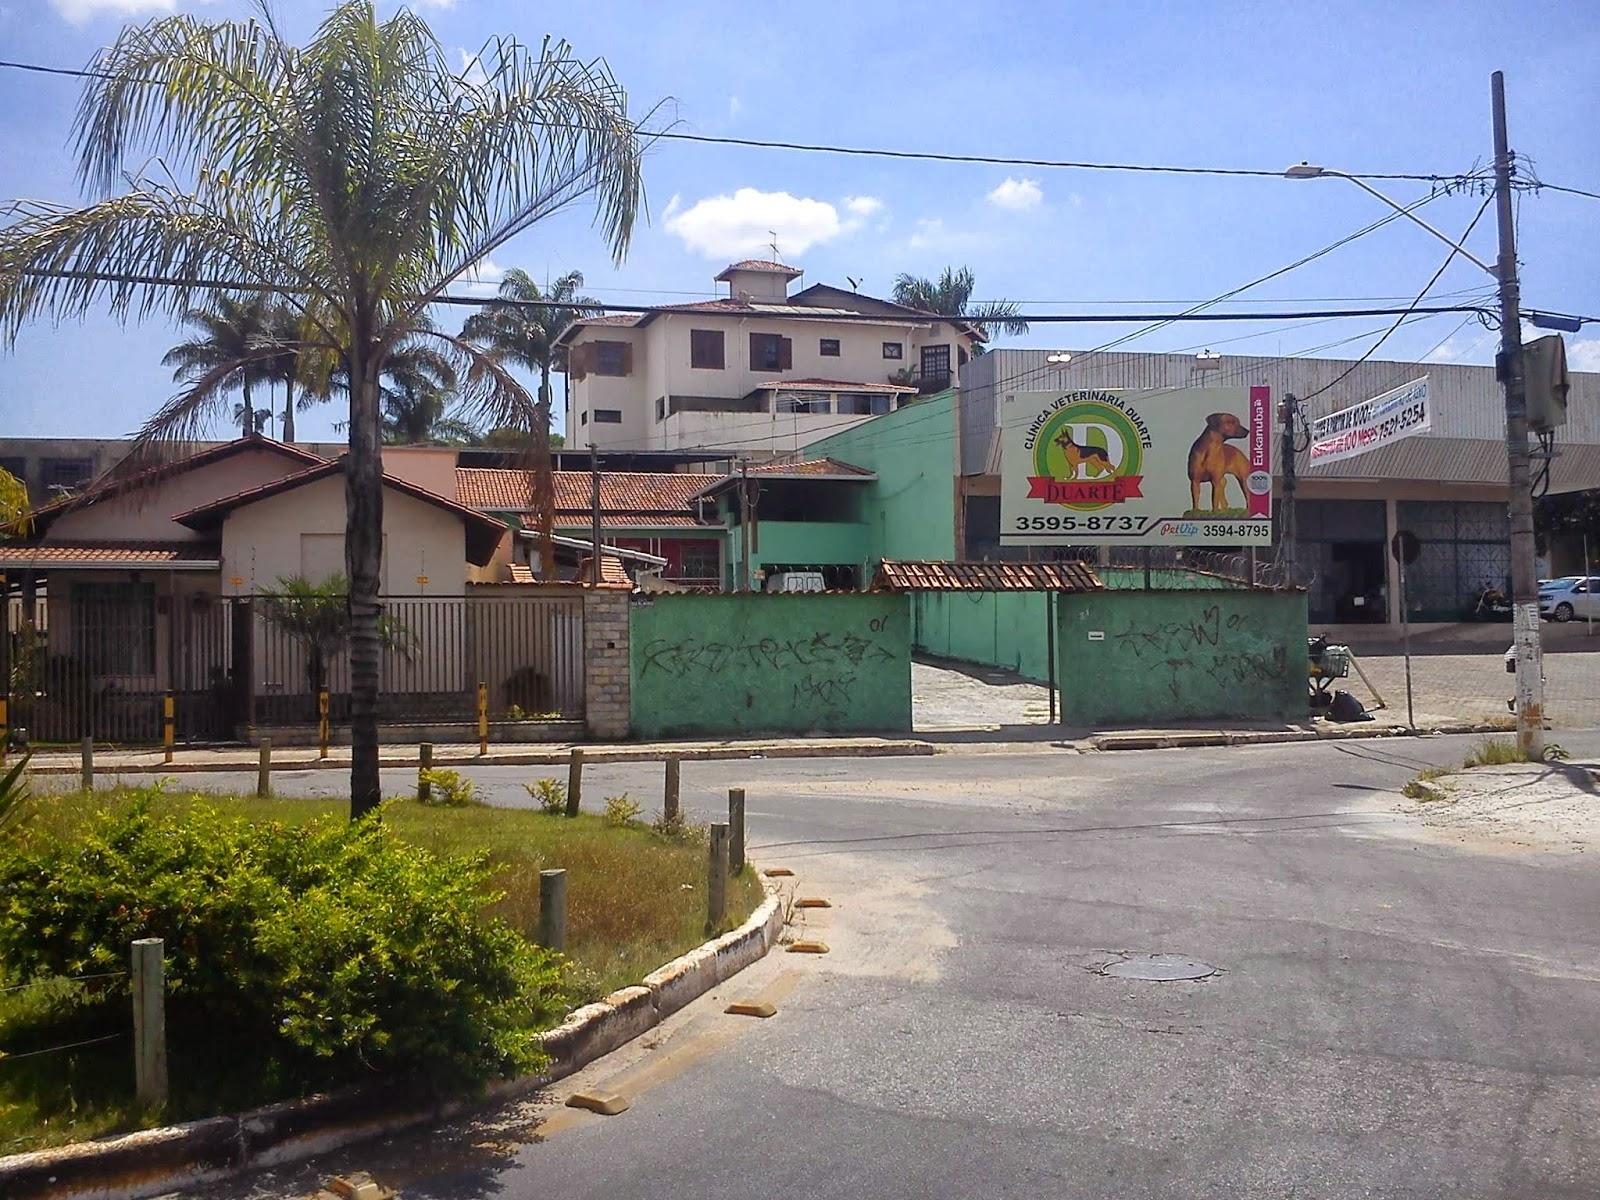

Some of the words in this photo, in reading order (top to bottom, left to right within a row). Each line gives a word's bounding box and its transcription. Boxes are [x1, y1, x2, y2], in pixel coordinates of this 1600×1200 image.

[1050, 390, 1125, 410] VETERINÁRIA
[1125, 407, 1152, 449] DUARTE
[1253, 406, 1264, 466] Eukanuba
[1047, 483, 1125, 500] DUARTE
[1016, 516, 1148, 530] 3595-8737
[1203, 525, 1269, 537] 3594-8795
